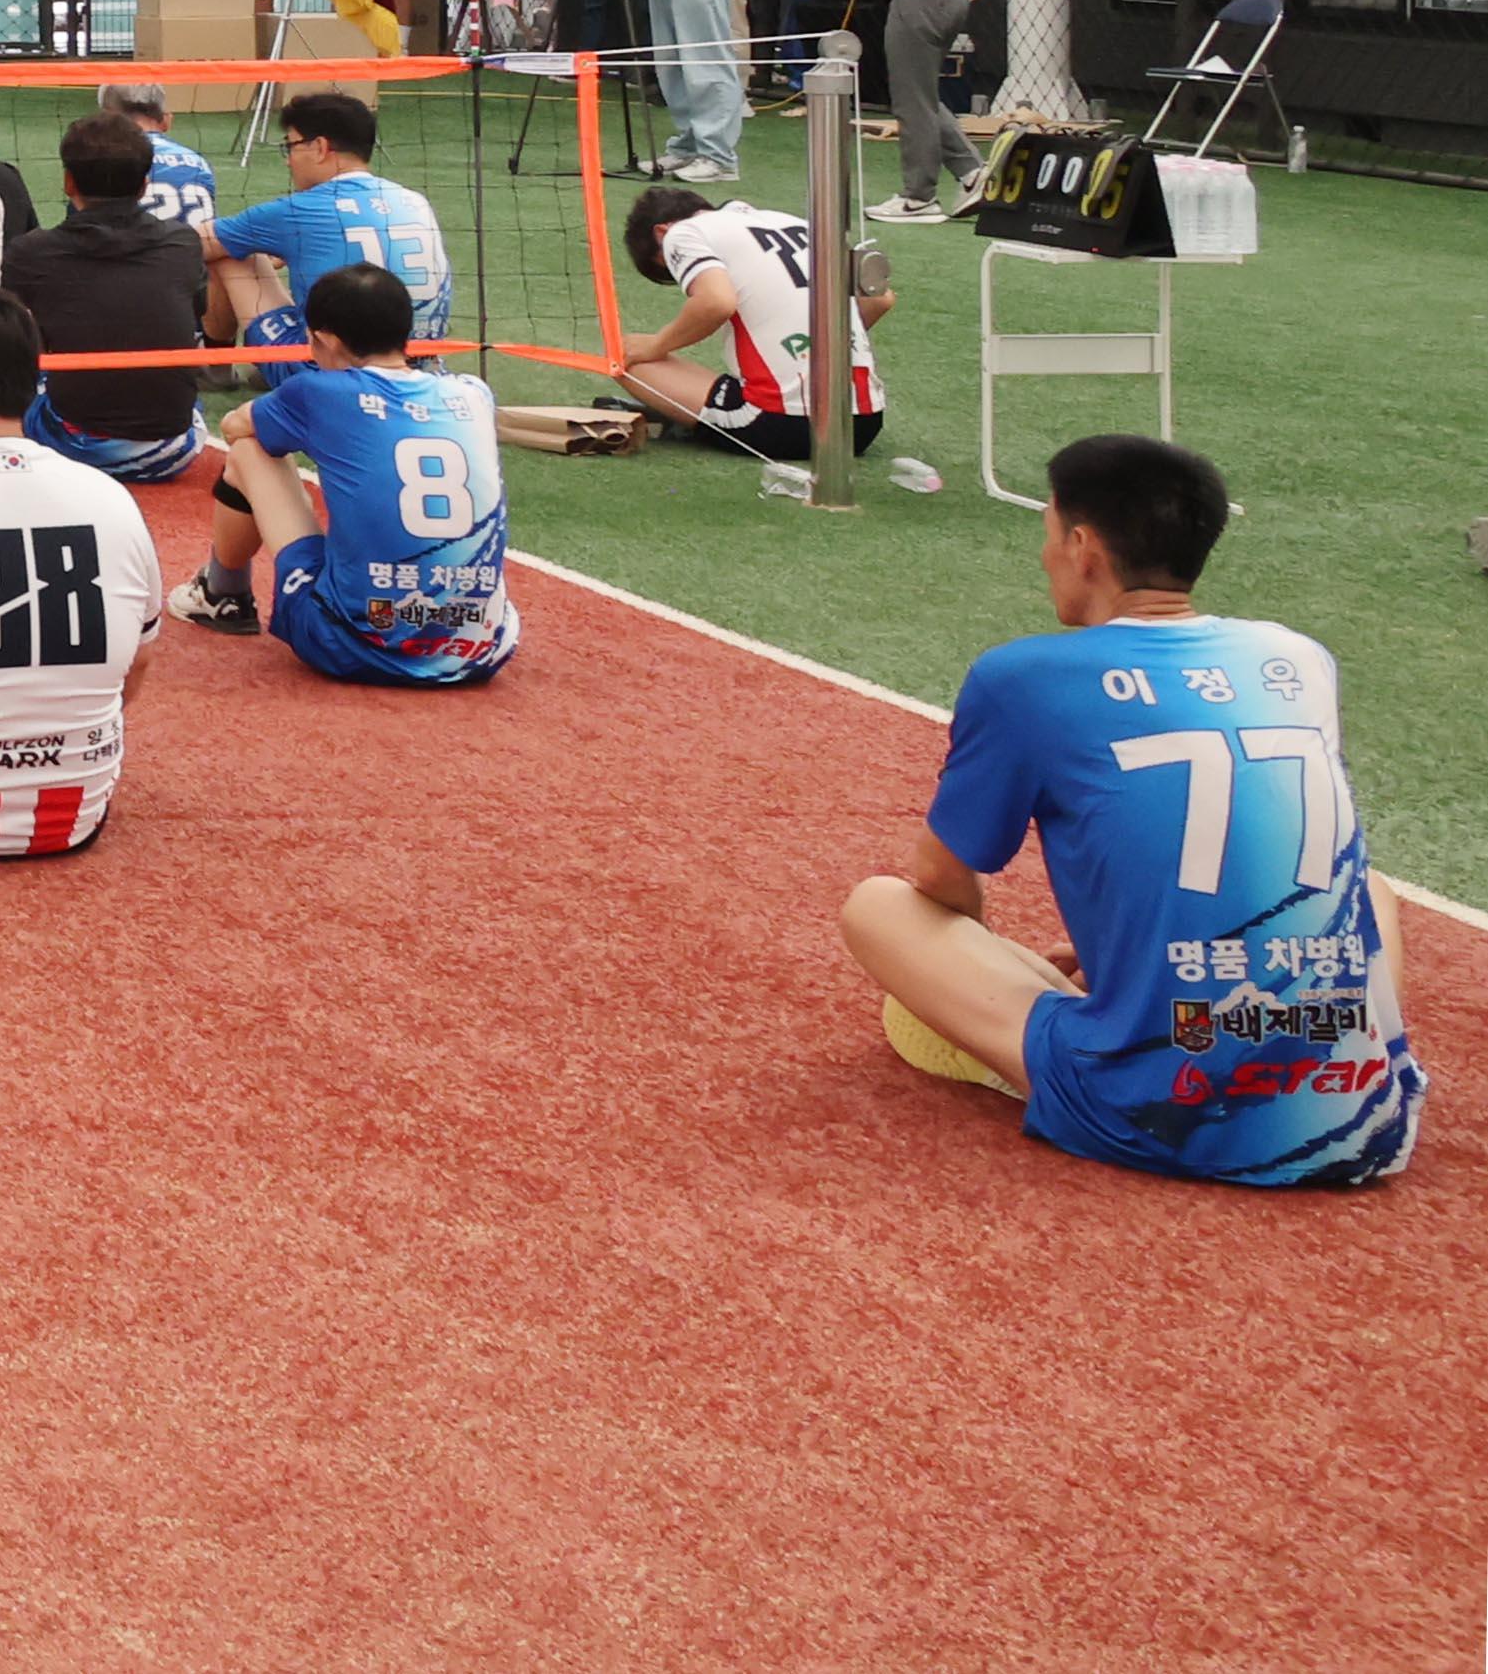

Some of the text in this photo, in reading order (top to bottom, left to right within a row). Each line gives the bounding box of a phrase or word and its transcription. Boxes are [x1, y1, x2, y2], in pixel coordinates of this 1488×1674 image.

[345, 224, 437, 302] 13
[394, 436, 475, 540] 8
[368, 561, 498, 593] 명품 차병원
[399, 603, 486, 630] 백제갈비
[1101, 656, 1305, 707] 이정우
[1109, 725, 1347, 897] 77
[1167, 932, 1368, 983] 명품 차병원
[1220, 1000, 1368, 1045] 백제갈비
